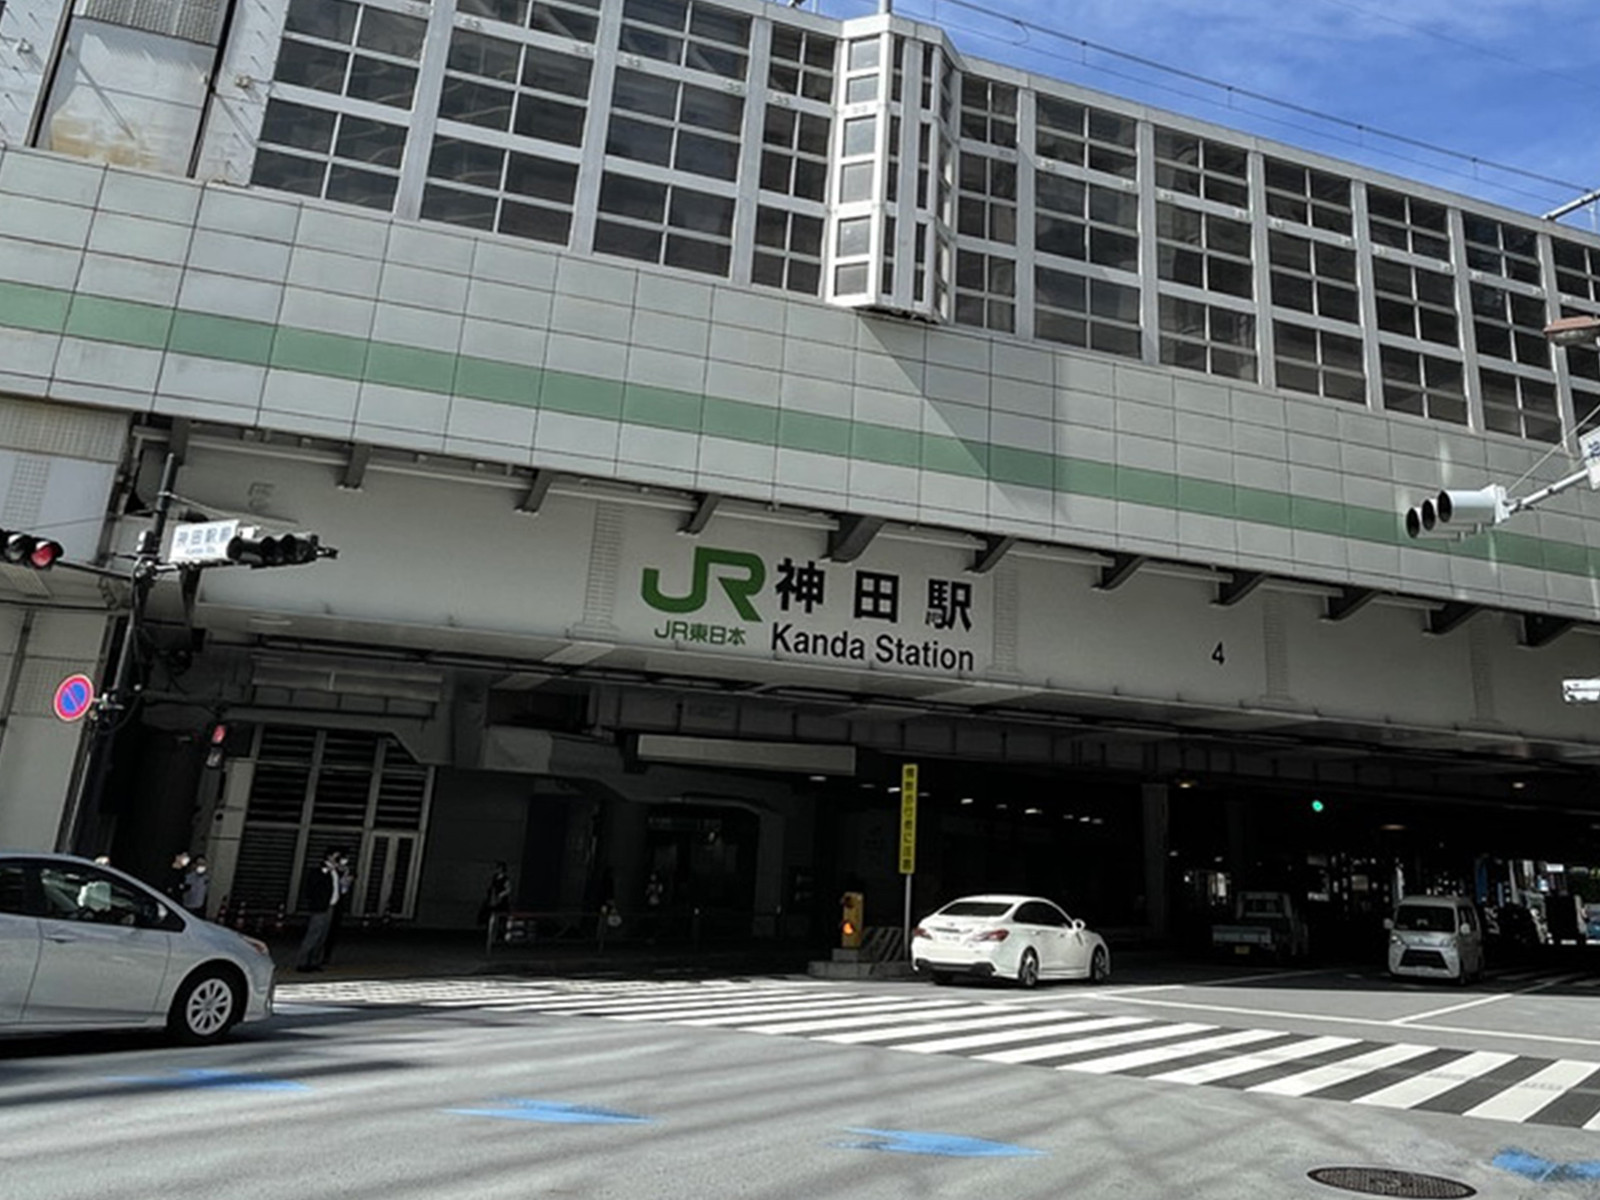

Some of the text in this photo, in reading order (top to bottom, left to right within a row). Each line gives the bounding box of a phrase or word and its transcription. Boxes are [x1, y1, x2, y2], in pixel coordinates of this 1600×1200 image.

[641, 546, 766, 622] JR
[775, 557, 973, 633] 神田駅
[653, 620, 746, 646] JR東日本
[771, 621, 974, 671] Kanda Station
[1211, 641, 1226, 666] 4
